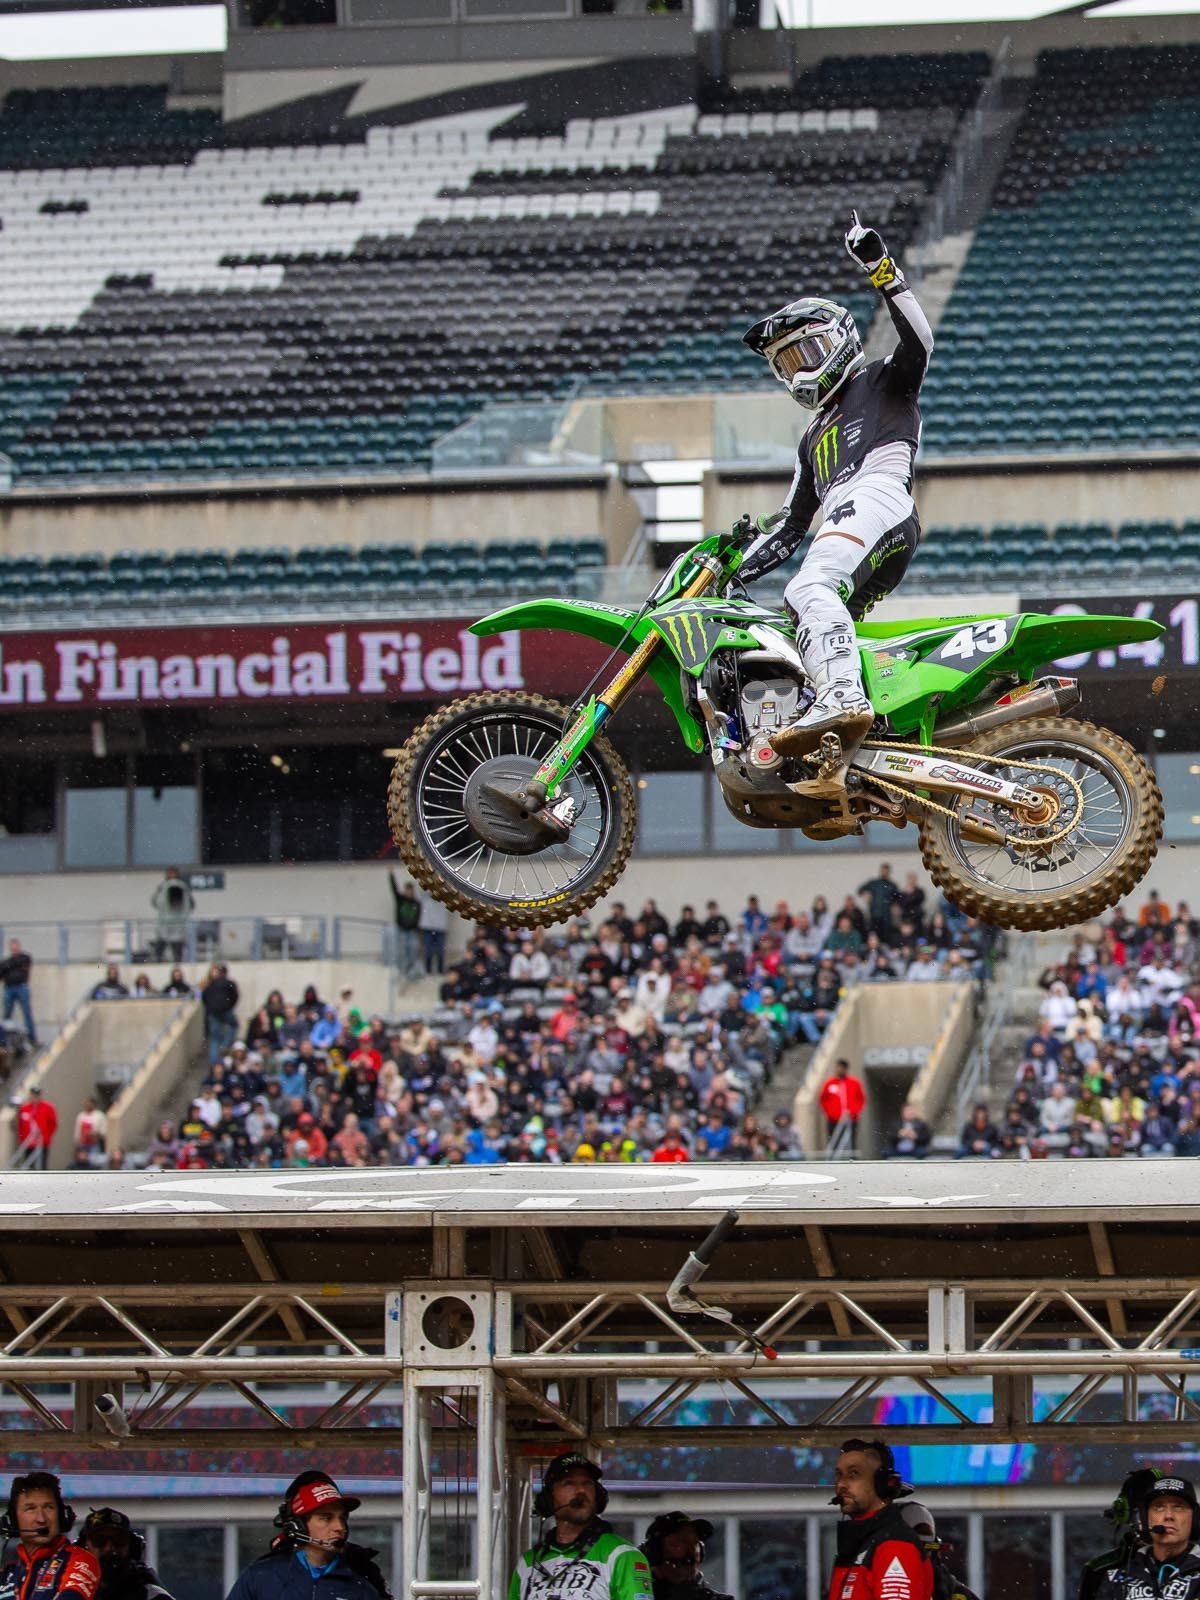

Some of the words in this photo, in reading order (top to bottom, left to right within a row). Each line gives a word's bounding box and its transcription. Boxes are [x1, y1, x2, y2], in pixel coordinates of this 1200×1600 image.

[829, 635, 853, 647] FOX
[940, 618, 1008, 660] 43
[55, 632, 350, 701] Financial
[360, 630, 524, 694] Field
[908, 758, 926, 768] RK
[929, 764, 1004, 790] RENTHAL
[508, 892, 567, 908] DUNLOP
[0, 1194, 992, 1212] AKLEY
